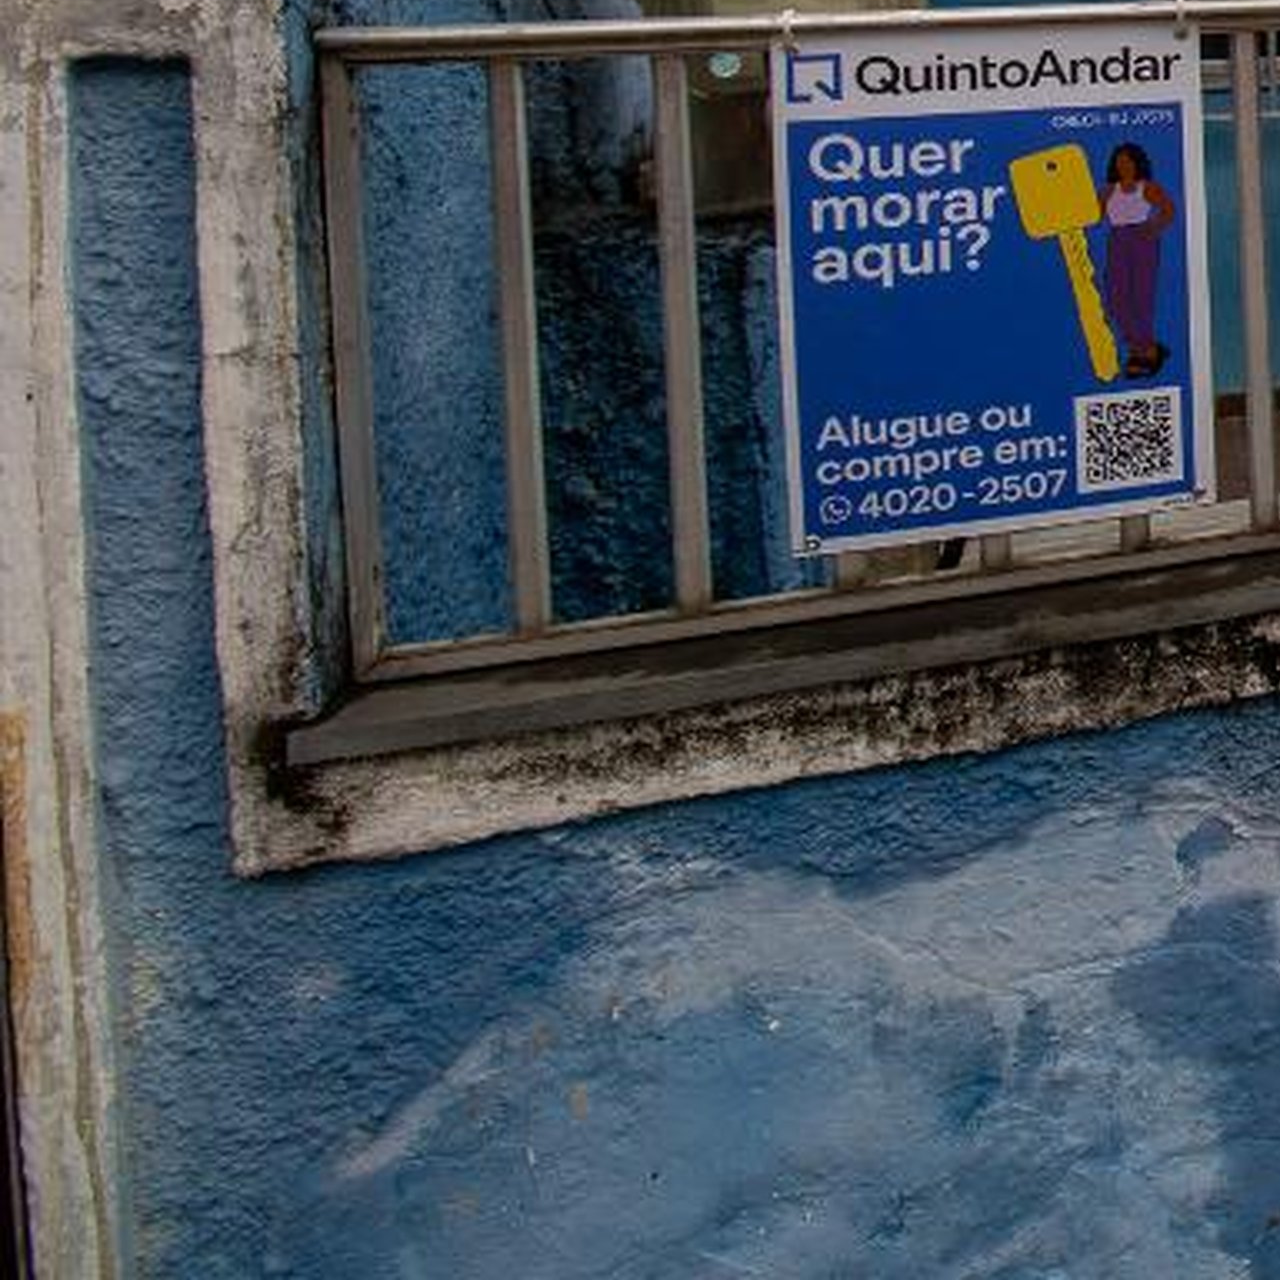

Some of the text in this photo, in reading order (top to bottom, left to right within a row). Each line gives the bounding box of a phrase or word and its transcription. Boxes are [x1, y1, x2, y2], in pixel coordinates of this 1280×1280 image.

[855, 46, 1181, 95] QuintoAndar
[808, 136, 974, 181] Quer
[810, 185, 1005, 232] morar
[811, 225, 990, 287] aqui?
[816, 407, 1032, 450] Alugue ou
[816, 434, 1067, 483] compre em:
